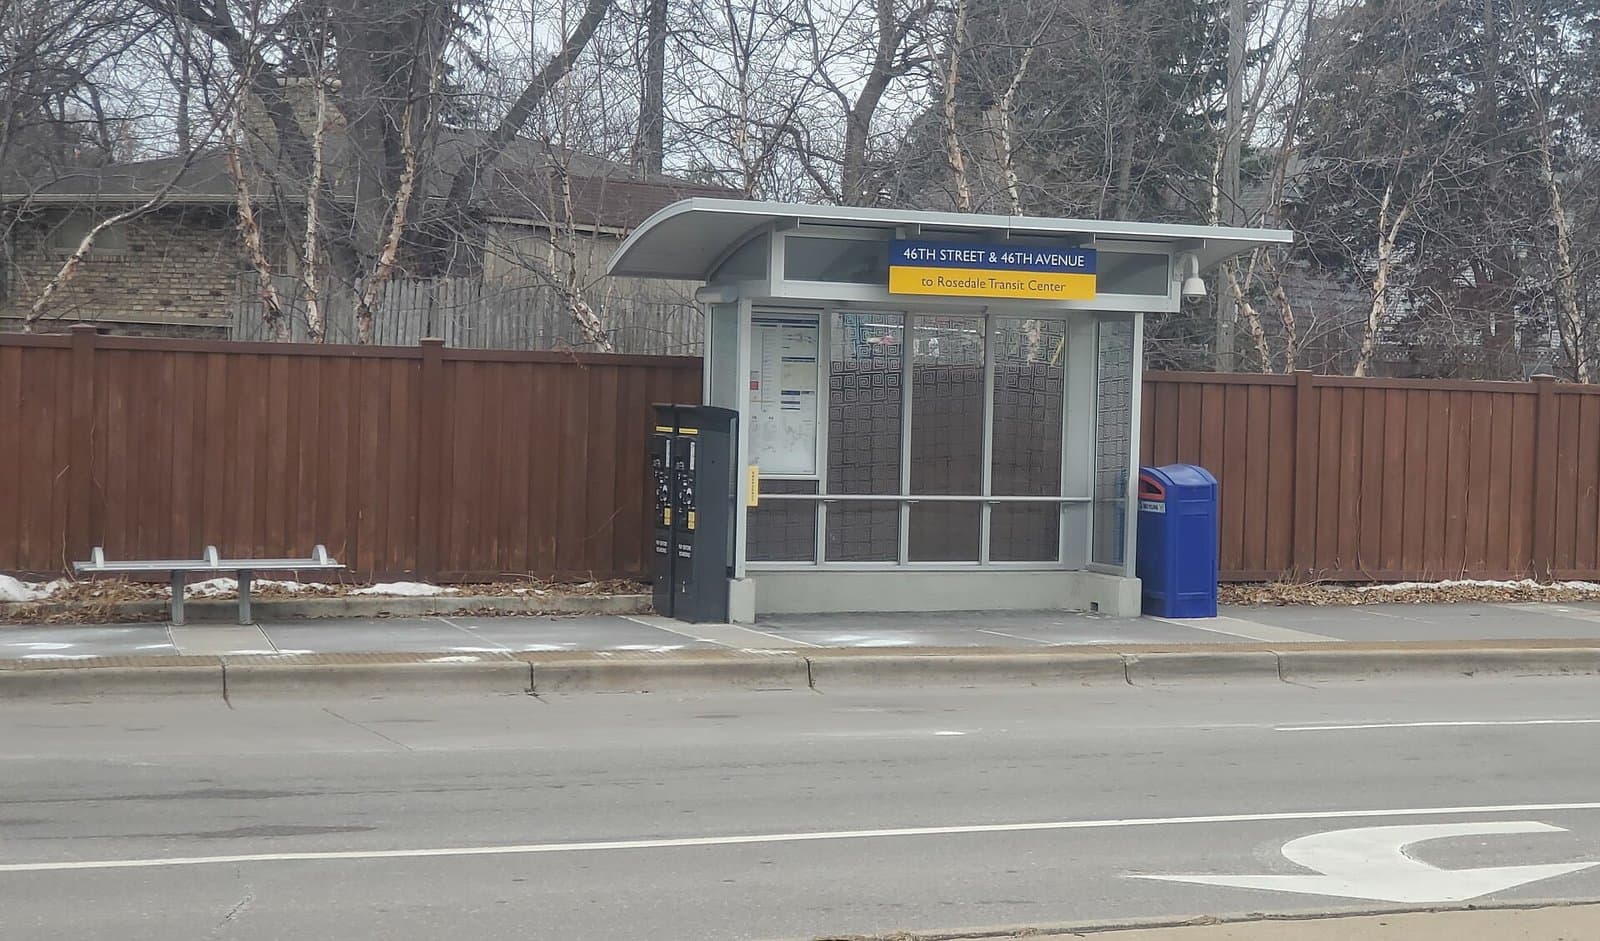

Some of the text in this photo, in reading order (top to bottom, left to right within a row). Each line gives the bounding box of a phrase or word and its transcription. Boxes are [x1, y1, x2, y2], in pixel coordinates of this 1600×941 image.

[903, 247, 1084, 267] 46TH STREET & 46TH AVENUE
[921, 275, 1066, 292] to Rosedale Transit Center
